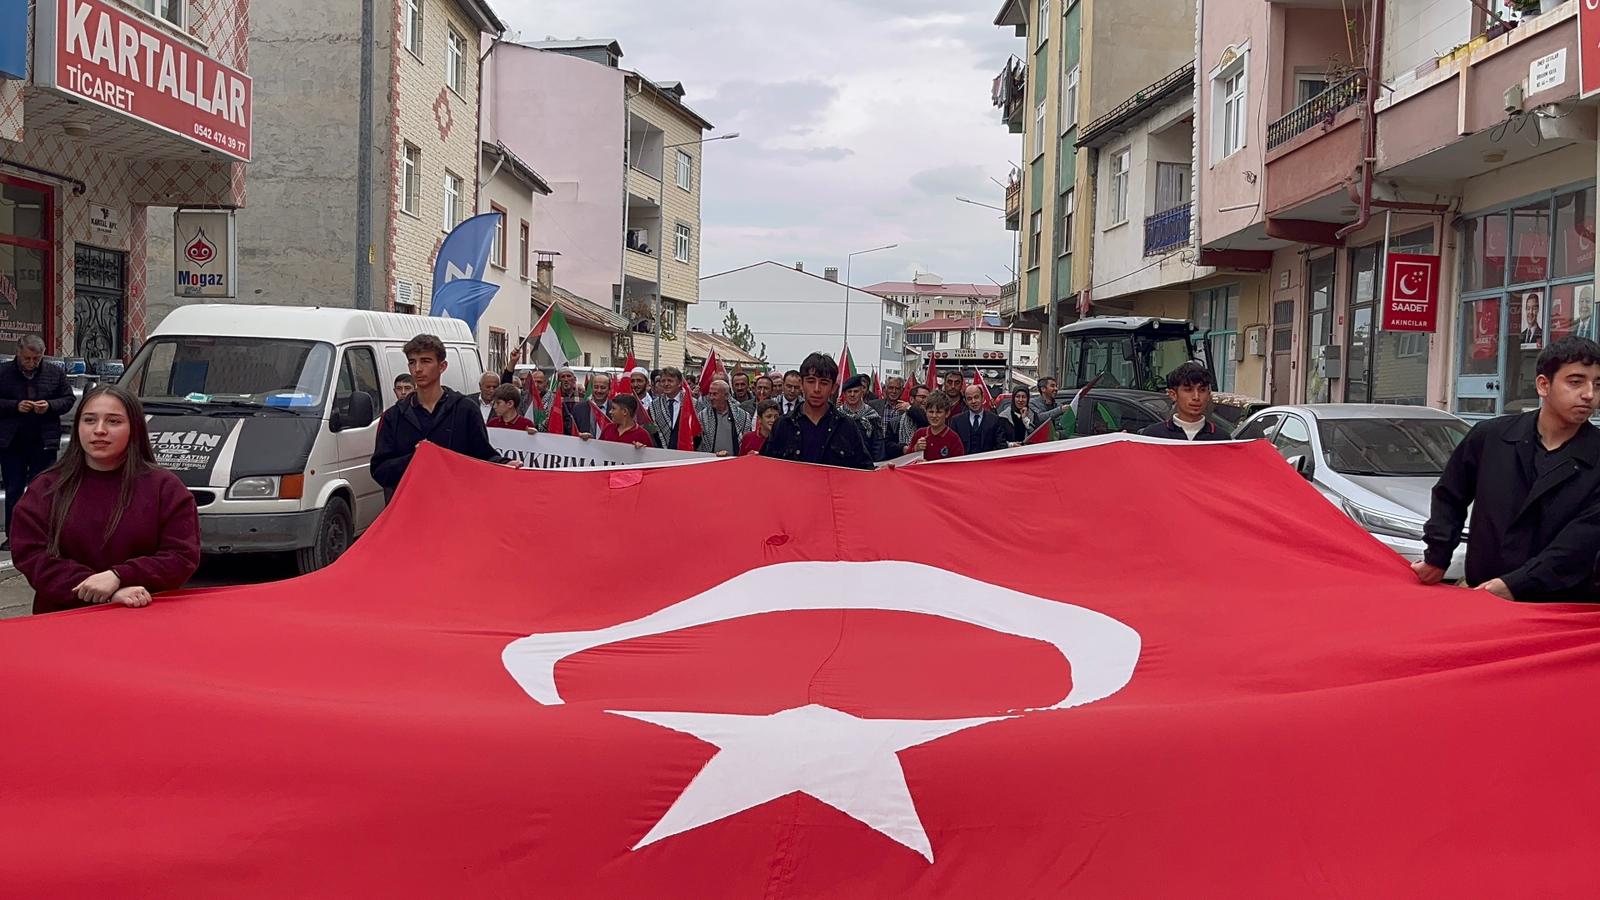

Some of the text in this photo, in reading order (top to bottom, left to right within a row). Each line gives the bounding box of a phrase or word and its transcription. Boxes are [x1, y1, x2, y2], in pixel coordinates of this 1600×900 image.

[66, 0, 246, 128] KARTALLAR
[66, 64, 135, 112] TİCARET
[194, 123, 246, 153] 0542 474 39 77
[178, 270, 223, 287] Mogaz
[1392, 302, 1429, 313] SAADET
[1391, 319, 1428, 327] AKINCILAR
